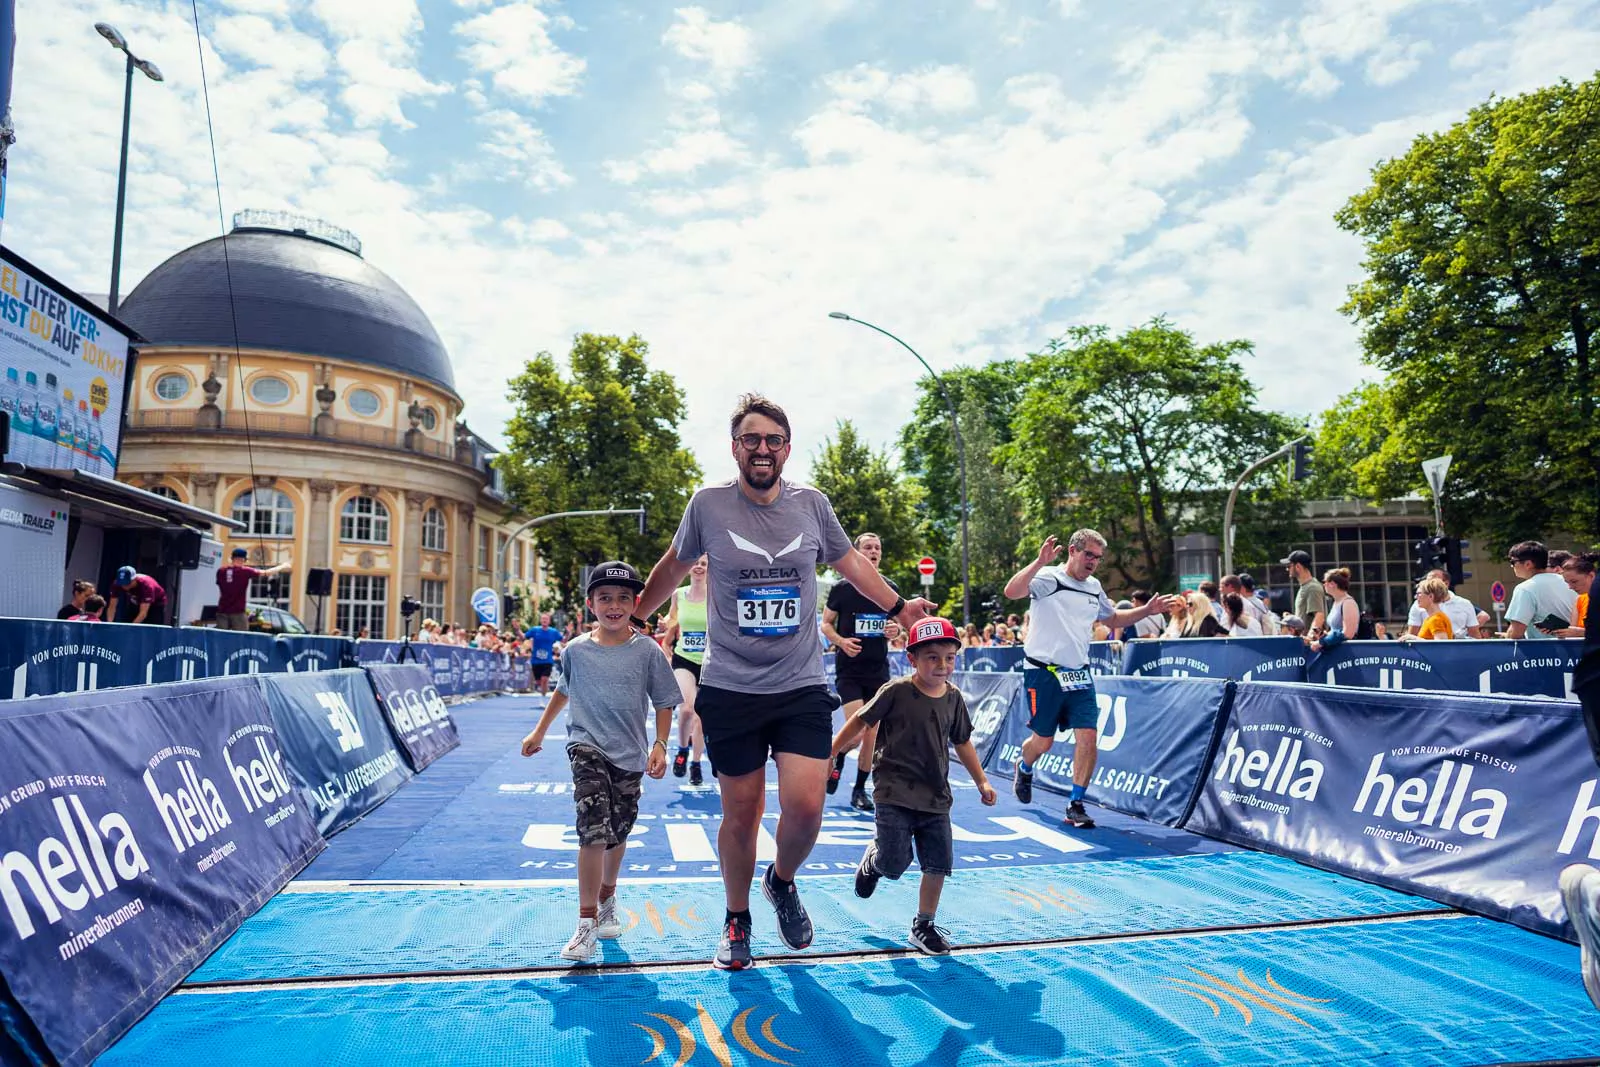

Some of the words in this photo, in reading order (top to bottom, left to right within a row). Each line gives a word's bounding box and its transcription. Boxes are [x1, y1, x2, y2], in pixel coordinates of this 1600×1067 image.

[23, 279, 68, 325] LITER
[70, 306, 100, 342] VER-
[29, 310, 52, 340] DU
[51, 323, 81, 355] AUF
[738, 568, 799, 579] SALEWA
[743, 599, 796, 621] 3176
[860, 620, 884, 630] 7190
[919, 625, 941, 638] FOX
[32, 649, 50, 665] VON
[53, 644, 79, 658] GRUND
[81, 645, 95, 655] AUF
[97, 647, 121, 665] FRISCH
[1142, 663, 1158, 672] VON
[1175, 656, 1186, 665] AUF
[1187, 658, 1210, 674] FRISCH
[1256, 660, 1273, 674] VON
[1276, 656, 1306, 669] GRUND
[1337, 660, 1352, 671] VON
[1354, 656, 1380, 666] GRUND
[1382, 656, 1398, 665] AUF
[1401, 658, 1432, 673] FRISCH
[1496, 661, 1519, 673] VON
[1523, 658, 1562, 668] GRUND
[1062, 670, 1087, 682] 8892
[1242, 724, 1258, 732] VON
[1260, 724, 1285, 732] GRUND
[1288, 726, 1302, 736] AUF
[1303, 730, 1334, 748] FRISCH
[1214, 729, 1324, 802] hella
[1391, 746, 1411, 757] VON
[1413, 745, 1446, 755] GRUND
[1447, 747, 1470, 758] AUF
[1474, 751, 1518, 774] FRISCH
[1000, 744, 1022, 763] DIE
[1032, 752, 1170, 801] UFGESLSCHAFT
[10, 780, 46, 804] GRUND
[48, 775, 67, 789] AUF
[67, 774, 107, 787] FRISCH
[311, 781, 341, 812] DIE
[1352, 752, 1508, 840] hella
[143, 760, 232, 853] hella
[1220, 790, 1290, 815] mineralbrunnen
[1363, 824, 1463, 856] mineralbrunnen
[960, 851, 1041, 863] VON
[58, 896, 145, 962] mineralbrunnen
